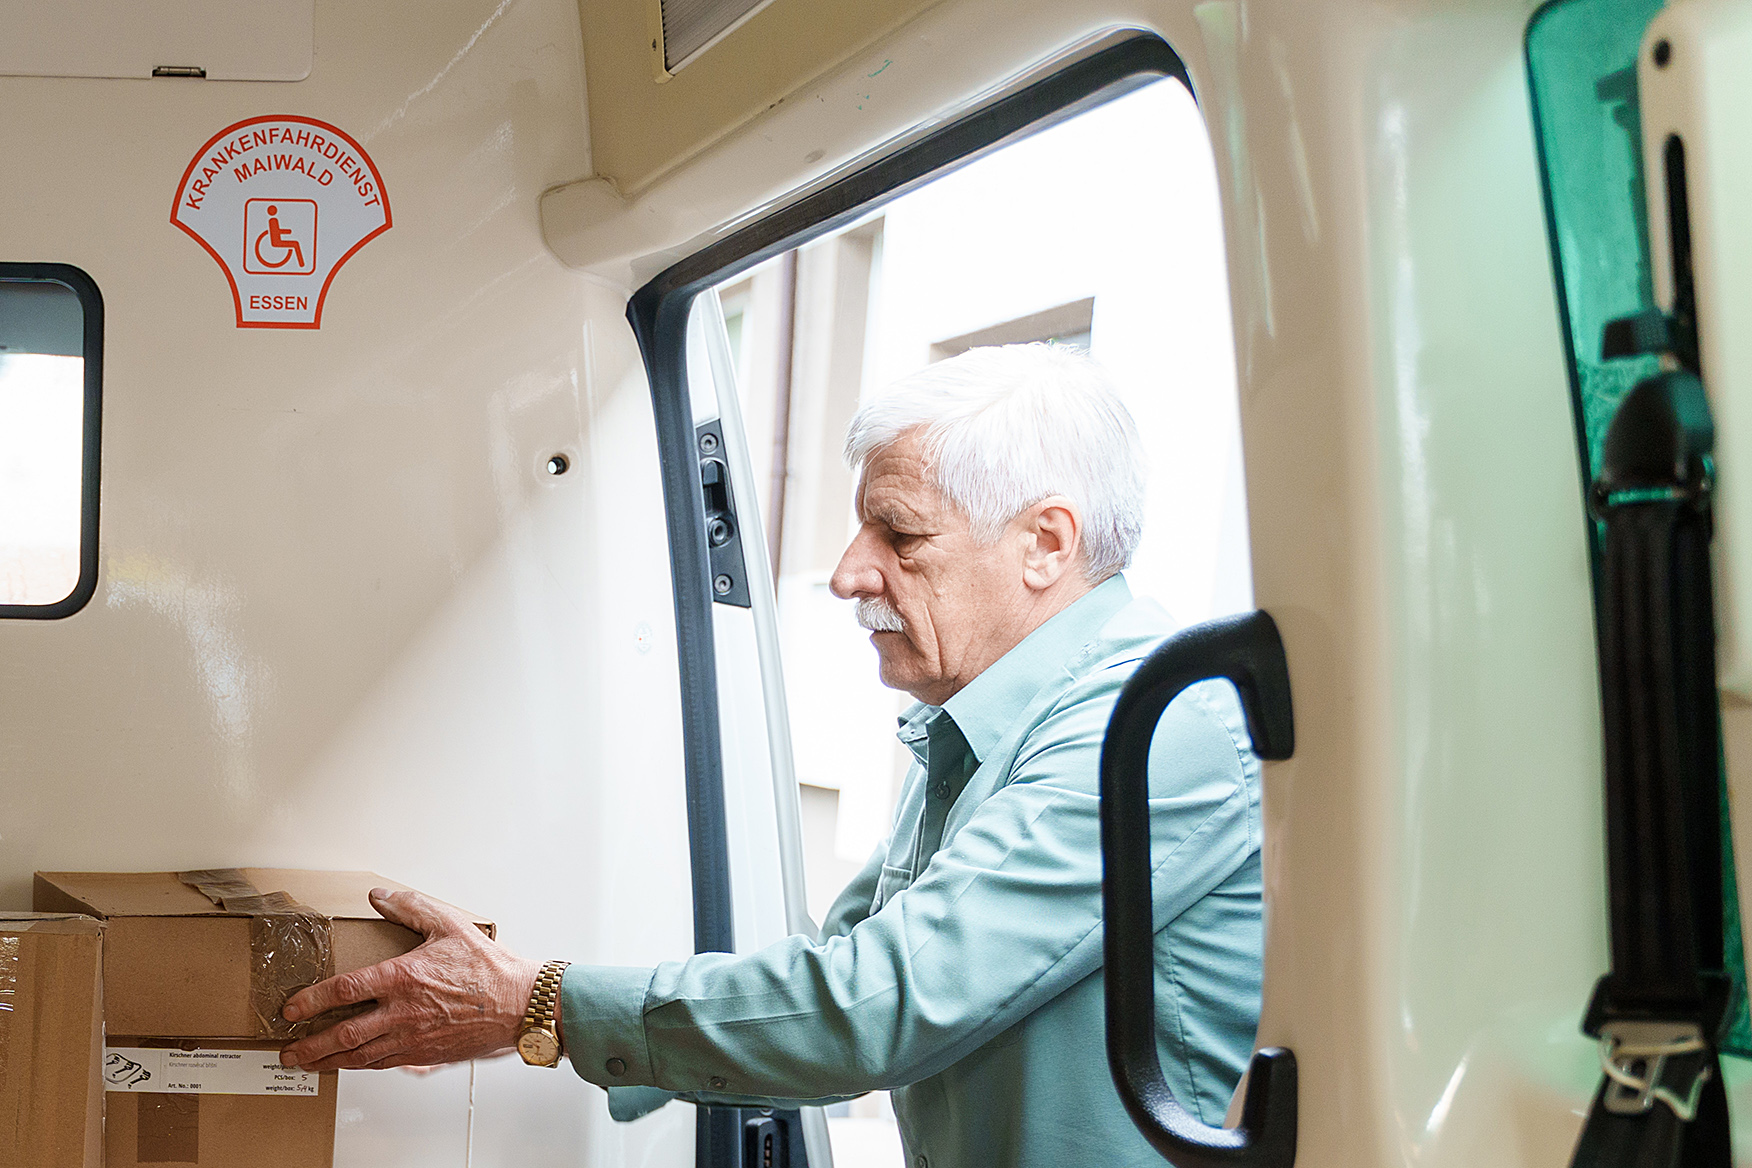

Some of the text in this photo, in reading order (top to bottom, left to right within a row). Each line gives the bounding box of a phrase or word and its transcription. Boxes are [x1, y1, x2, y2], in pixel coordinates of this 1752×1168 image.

[185, 127, 381, 210] KRANKENFAHRDIENST
[233, 154, 334, 187] MAIWALD
[249, 295, 308, 311] ESSEN
